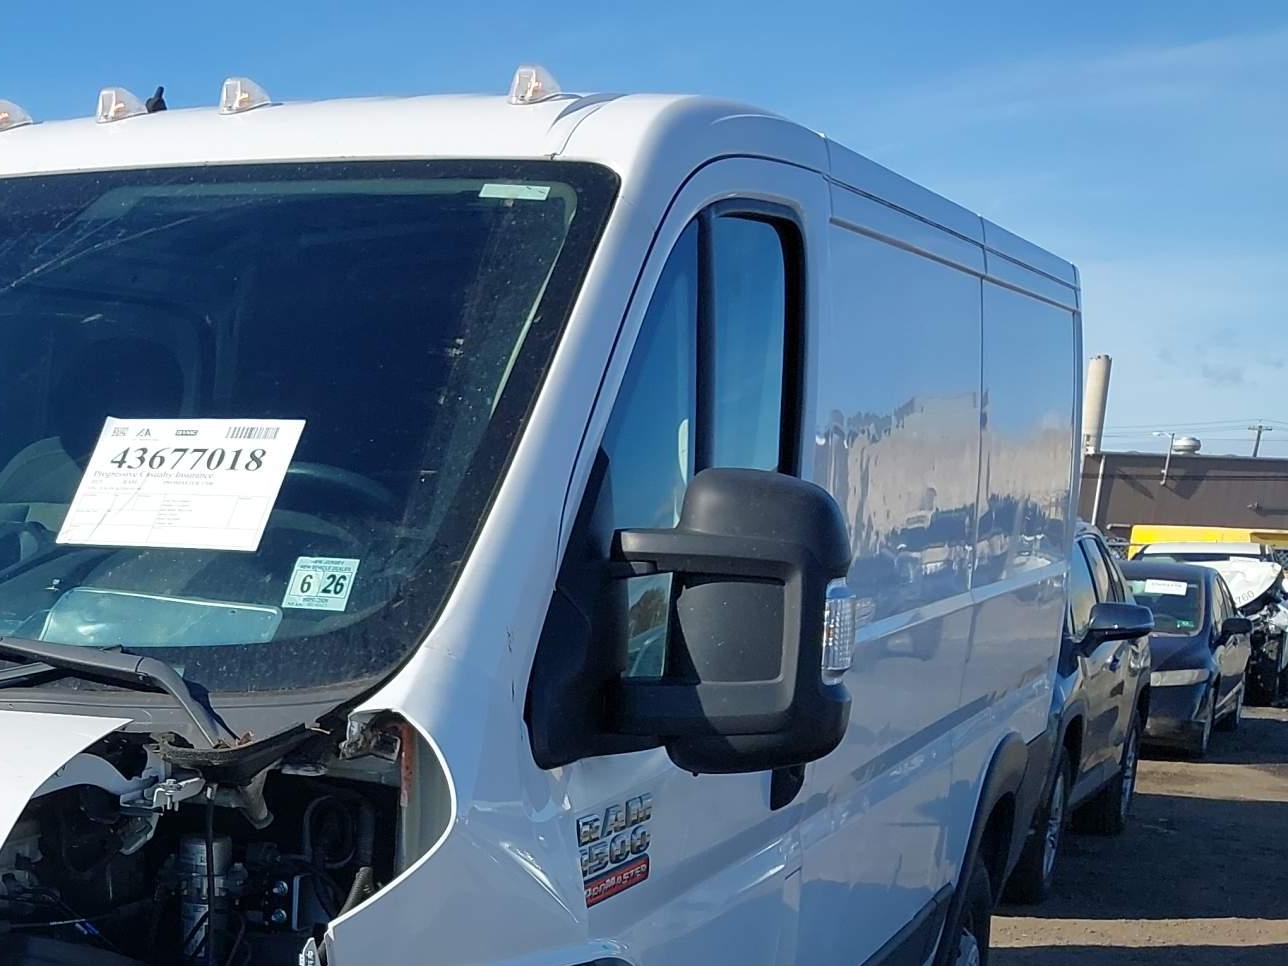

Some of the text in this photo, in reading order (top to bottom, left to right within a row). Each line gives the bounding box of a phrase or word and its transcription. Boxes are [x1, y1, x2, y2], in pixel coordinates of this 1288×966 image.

[110, 447, 267, 472] 43677018
[300, 574, 347, 595] 6 26
